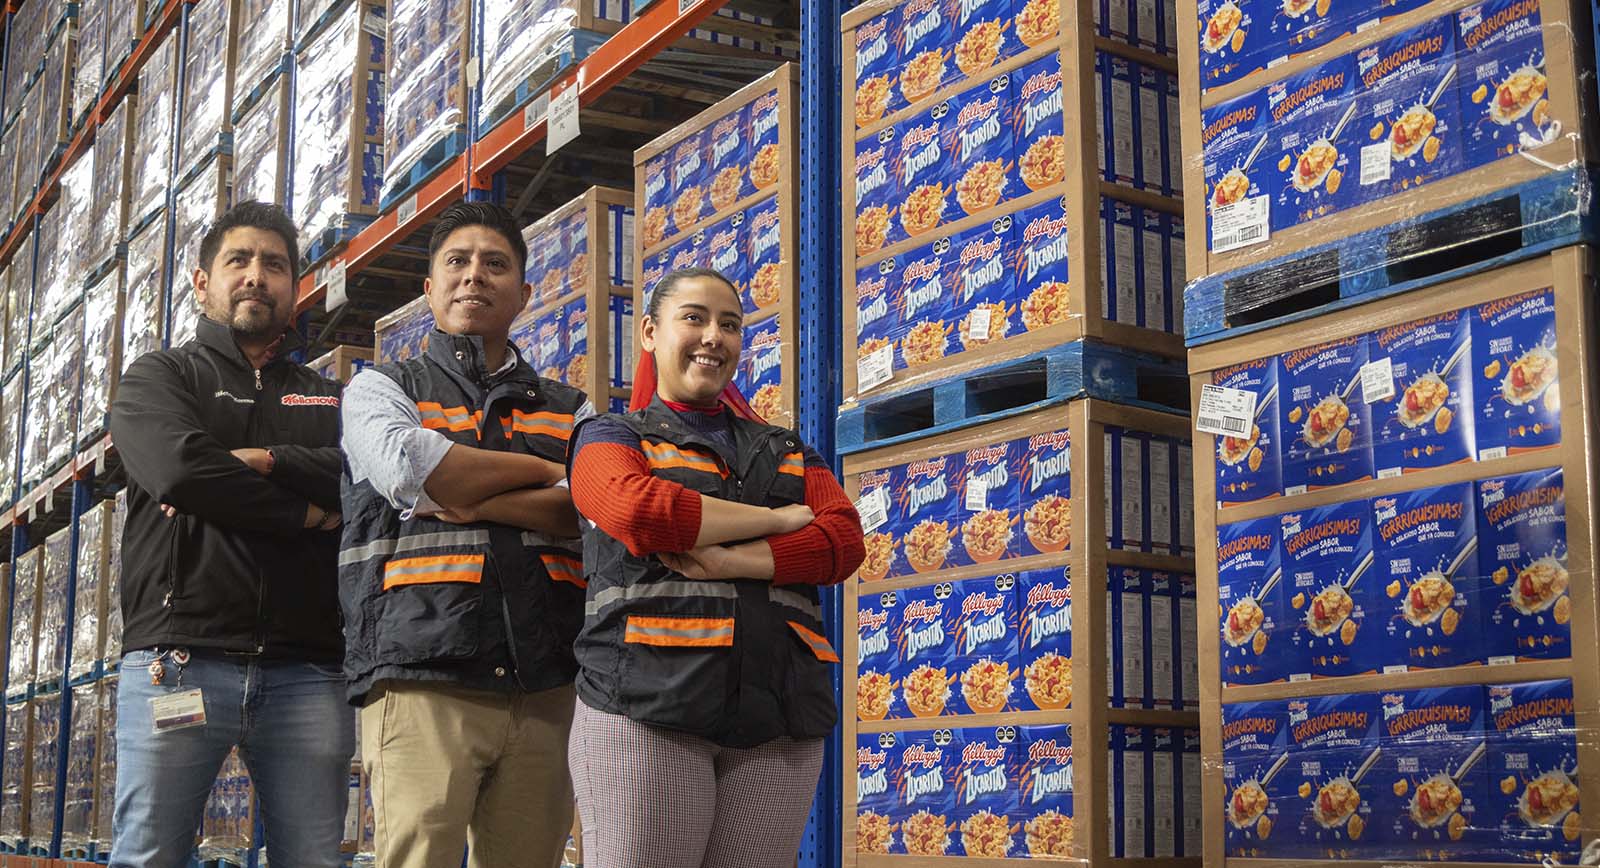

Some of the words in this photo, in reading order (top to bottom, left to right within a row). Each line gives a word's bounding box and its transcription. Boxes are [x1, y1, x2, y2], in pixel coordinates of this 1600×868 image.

[903, 5, 942, 55] ZUCARITAS
[1505, 18, 1530, 34] SABOR
[1363, 35, 1443, 88] ¡GRRRIQUÍSIMAS!
[1400, 59, 1420, 74] SABOR
[958, 95, 999, 126] Kellogg's
[1273, 73, 1344, 122] ¡GRRRIQUÍSIMAS!
[1305, 95, 1324, 110] SABOR
[752, 104, 778, 146] ZUCARIT
[1022, 86, 1063, 138] ZUCARITA
[902, 122, 940, 151] Kellogg's
[958, 112, 1000, 163] ZUCARITAS
[1221, 126, 1238, 139] SABOR
[903, 137, 942, 187] ZUCARITAS
[753, 222, 780, 264] ZUCARIT
[960, 236, 1002, 264] Kellogg's
[903, 257, 942, 284] Kellogg's
[1024, 232, 1068, 283] ZUCARITA
[961, 253, 1003, 303] ZUCARITAS
[904, 273, 942, 320] ZUCARITAS
[1522, 296, 1546, 312] SABOR
[1414, 324, 1436, 338] SABOR
[753, 344, 782, 384] ZUCARIT
[1318, 350, 1338, 362] SABOR
[1232, 372, 1248, 384] SABOR
[966, 442, 1008, 466] Kellogg's
[1028, 431, 1070, 451] Kellogg
[906, 456, 948, 479] Kellogg's
[966, 460, 1008, 491] RITAS
[1030, 447, 1070, 493] ZUCARITA
[907, 474, 948, 519] ZUCARITAS
[1380, 502, 1464, 542] ¡GRRRIQUÍSIMAS!
[1528, 504, 1555, 518] SABOR
[1285, 518, 1360, 556] ¡GRRRIQUÍSIMAS!
[1418, 522, 1440, 534] SABOR
[1217, 534, 1272, 562] RRIQUÍSIMAS!
[1320, 537, 1340, 550] SABOR
[1235, 552, 1252, 564] SABOR
[904, 600, 943, 623] Kellogg's
[962, 592, 1005, 616] Kellogg's
[963, 612, 1007, 656] ZUCARITAS
[1028, 604, 1072, 648] ZUCARITA
[905, 619, 944, 662] ZUCARITAS
[1223, 716, 1276, 740] RRIQUÍSIMAS!
[1292, 711, 1368, 744] ¡GRRRIQUÍSIMAS!
[1387, 703, 1470, 736] ¡GRRRIQUÍSIMAS!
[1426, 723, 1448, 734] SABOR
[1536, 717, 1564, 730] SABOR
[1240, 734, 1257, 744] SABOR
[1326, 729, 1347, 740] SABOR
[902, 744, 942, 768] Kellogg's
[962, 741, 1005, 766] Kellogg's
[1028, 738, 1072, 766] Kellogg
[904, 765, 944, 806] ZUCARITAS
[964, 764, 1007, 805] ZUCARITAS
[1031, 763, 1072, 804] ZUCARITA
